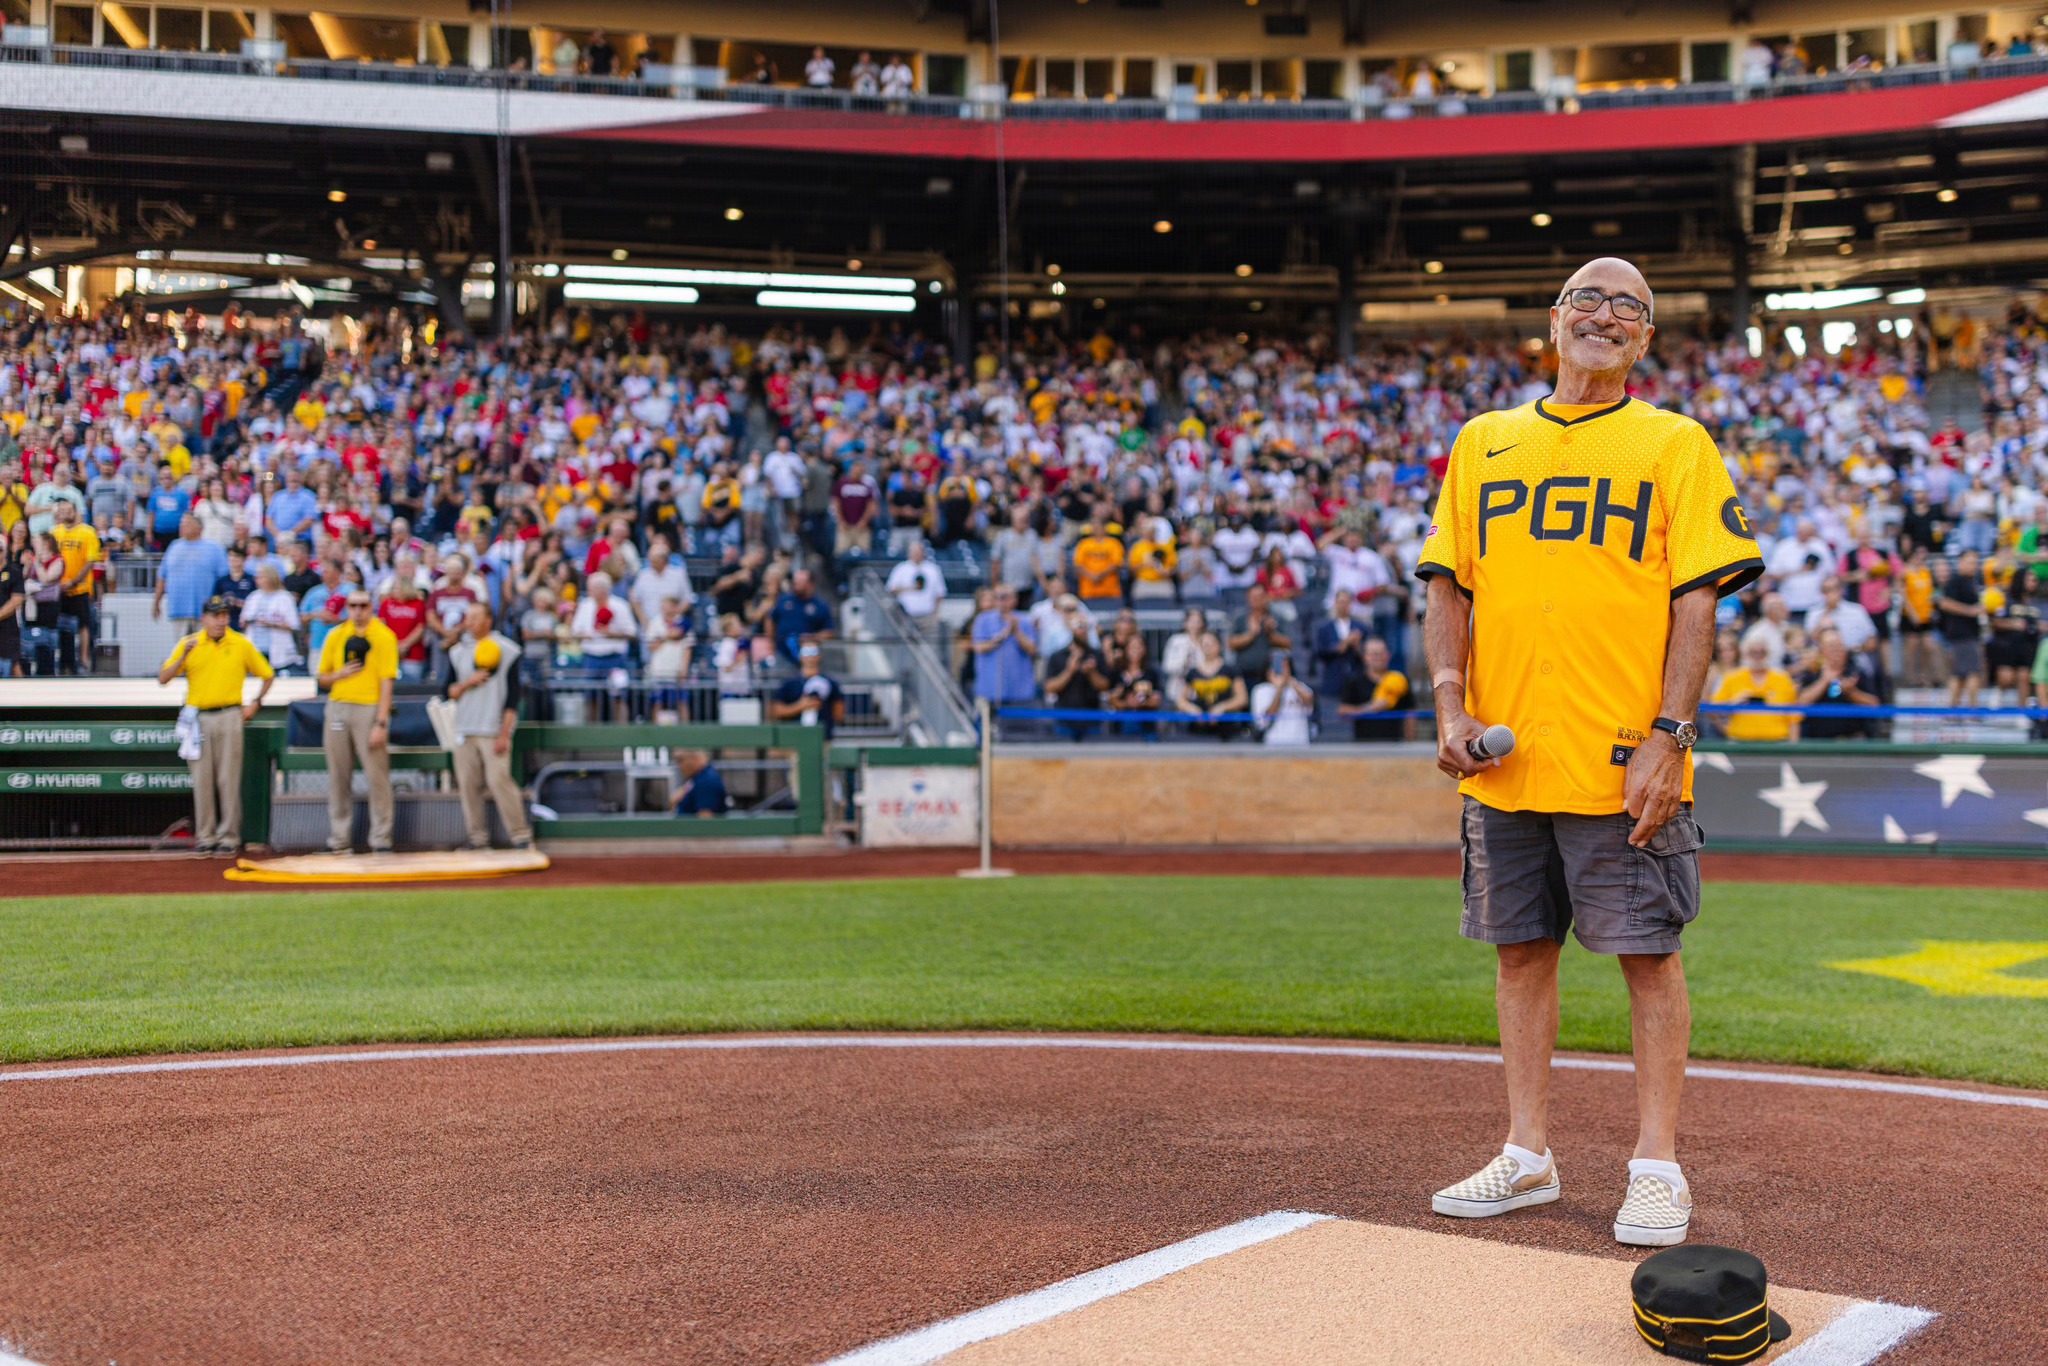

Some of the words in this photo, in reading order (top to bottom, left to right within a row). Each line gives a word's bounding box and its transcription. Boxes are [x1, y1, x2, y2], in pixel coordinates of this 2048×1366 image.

[1478, 475, 1654, 563] PGH
[24, 729, 91, 743] HYUNDAI
[137, 729, 180, 743] HYUN
[35, 773, 102, 787] HYUNDAI
[148, 773, 194, 788] HYUN
